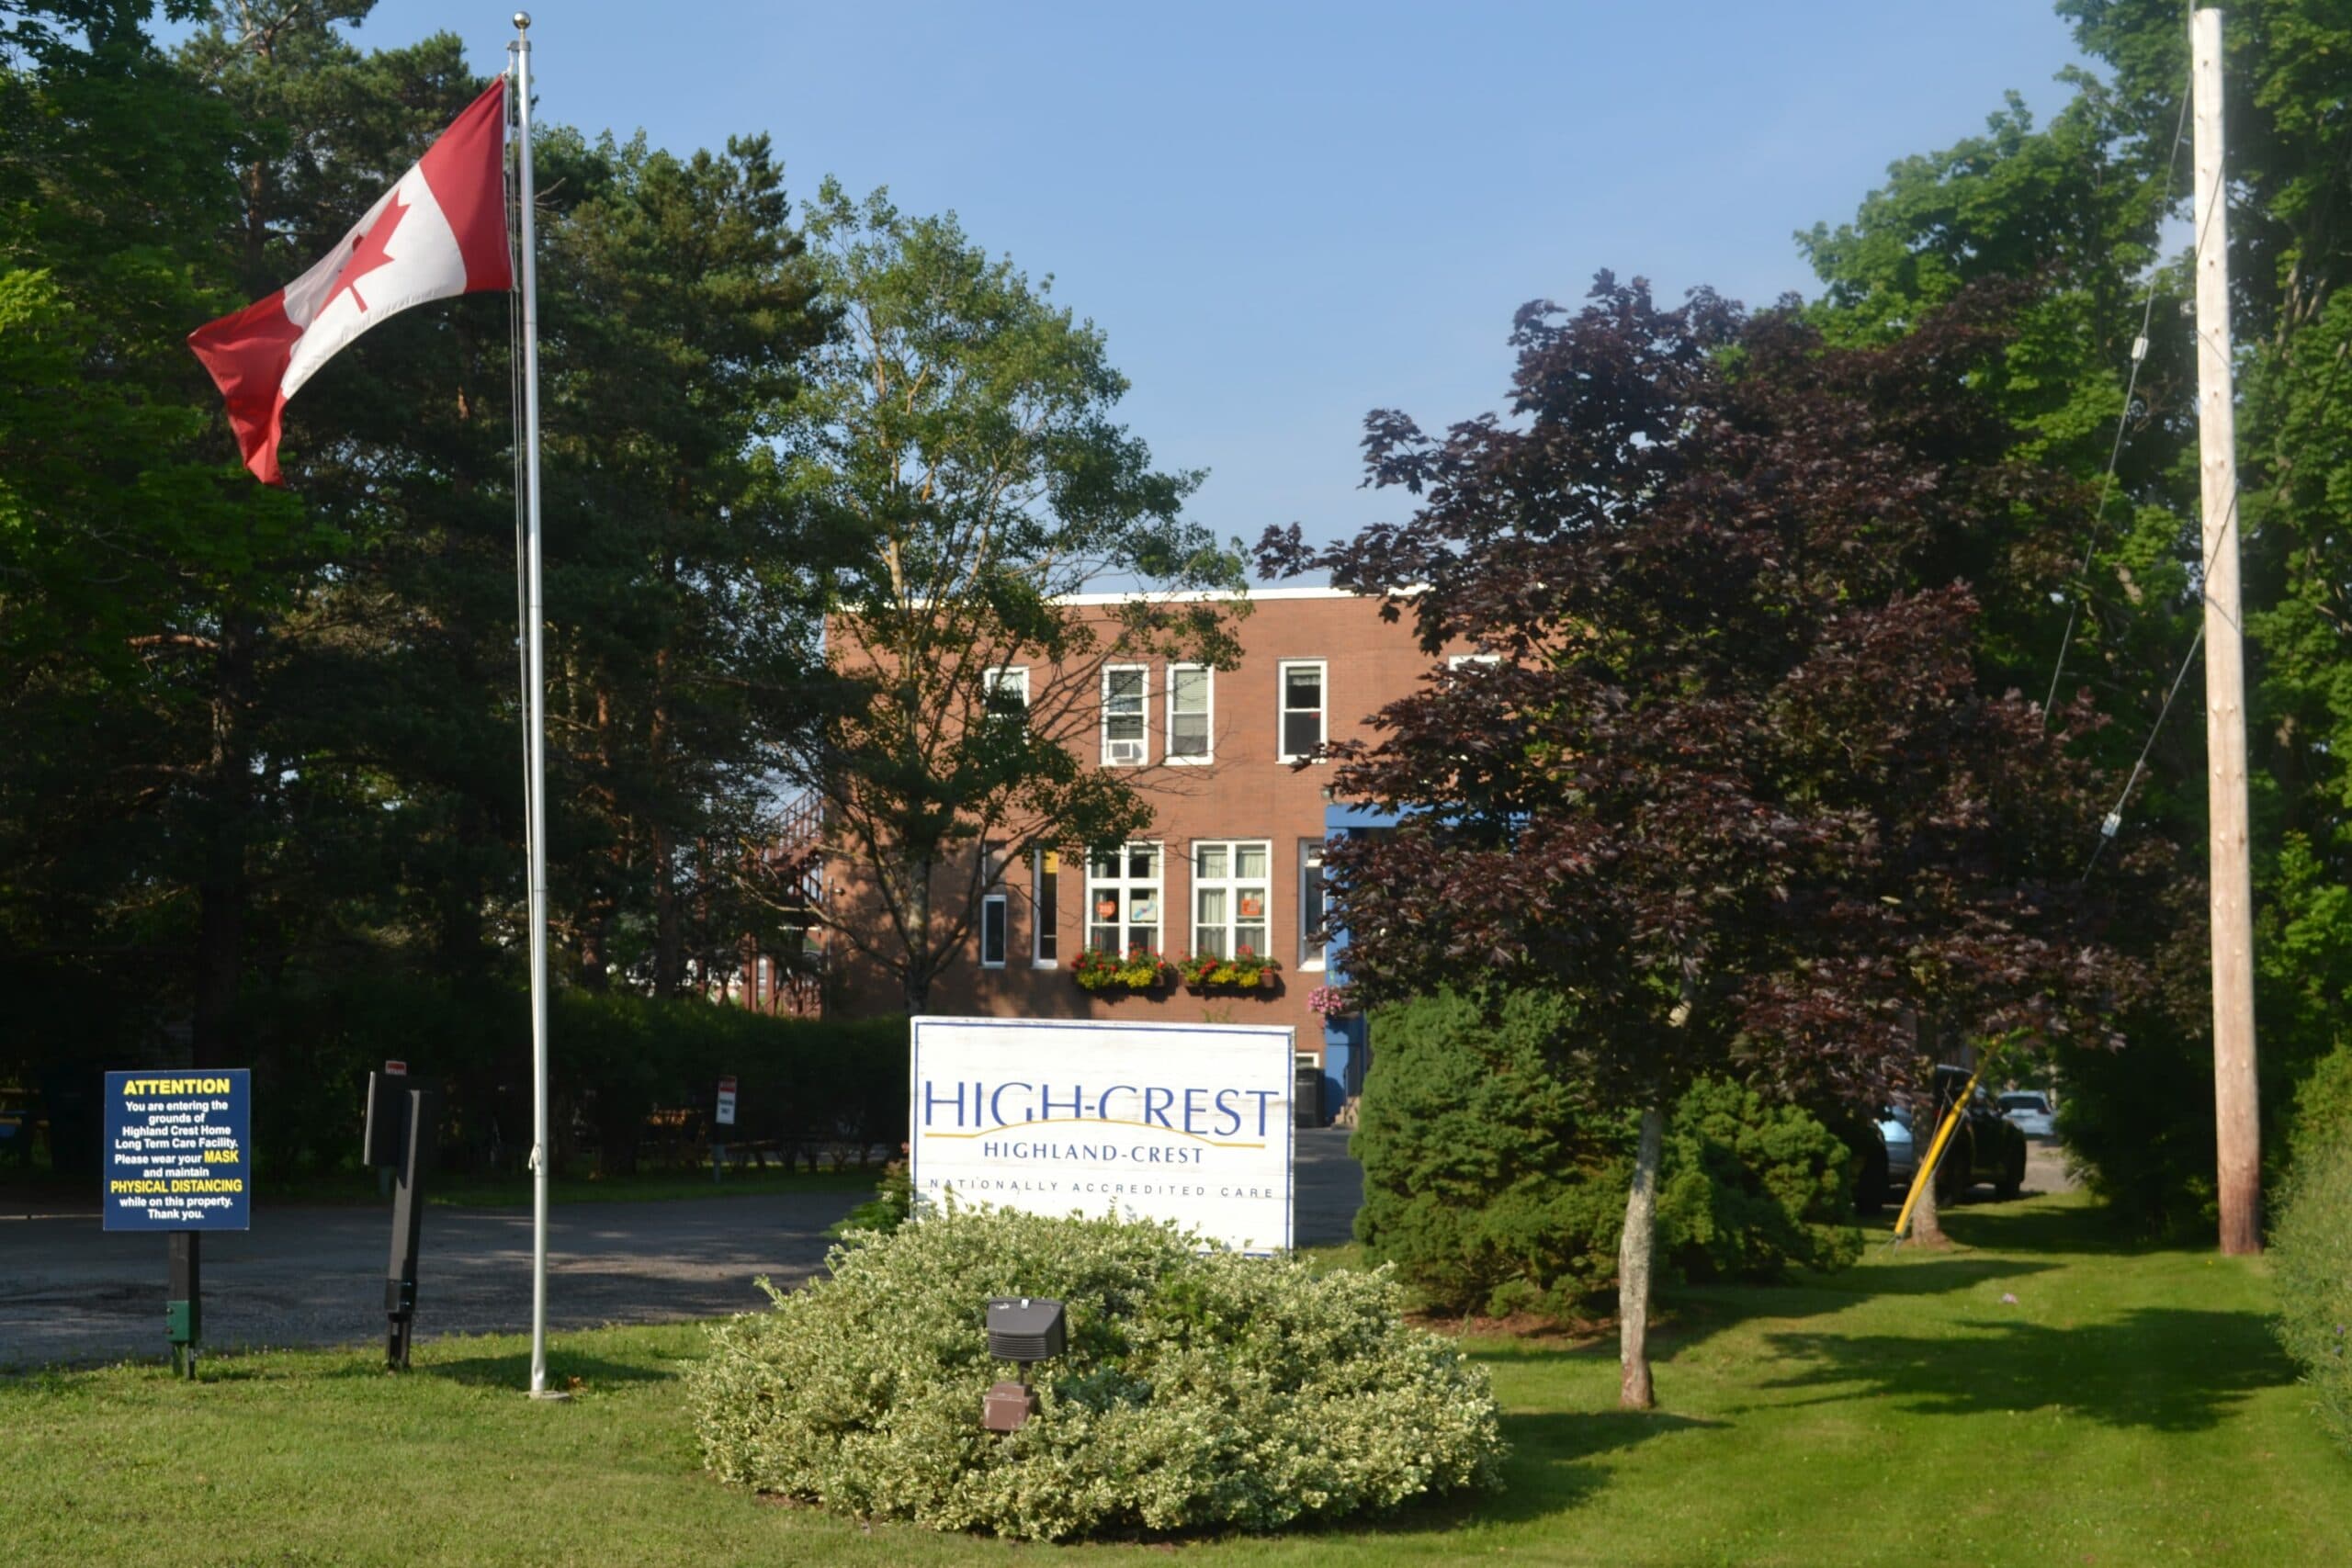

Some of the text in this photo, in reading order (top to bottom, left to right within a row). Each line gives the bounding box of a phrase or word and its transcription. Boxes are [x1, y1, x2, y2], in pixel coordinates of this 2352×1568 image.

[123, 1078, 230, 1095] ATTENTION
[125, 1101, 145, 1111] You
[166, 1100, 209, 1112] entering
[211, 1100, 228, 1111] the
[925, 1080, 1279, 1136] HIGH-CREST
[148, 1112, 205, 1125] grounds of
[122, 1125, 231, 1138] Highland Crest Home
[115, 1137, 238, 1151] Long Term Care Facility.
[115, 1154, 149, 1164] Please
[178, 1156, 202, 1165] your
[204, 1150, 239, 1163] MASK
[984, 1142, 1204, 1164] HIGHLAND-CREST
[143, 1168, 209, 1178] and maintain
[110, 1179, 243, 1193] PHYSICAL DISTANCING
[930, 1179, 1273, 1198] NATIONALLY ACCREDITED CARE
[119, 1197, 146, 1207] while
[164, 1196, 184, 1206] this
[187, 1197, 232, 1208] property.
[148, 1209, 205, 1221] Thank you.
